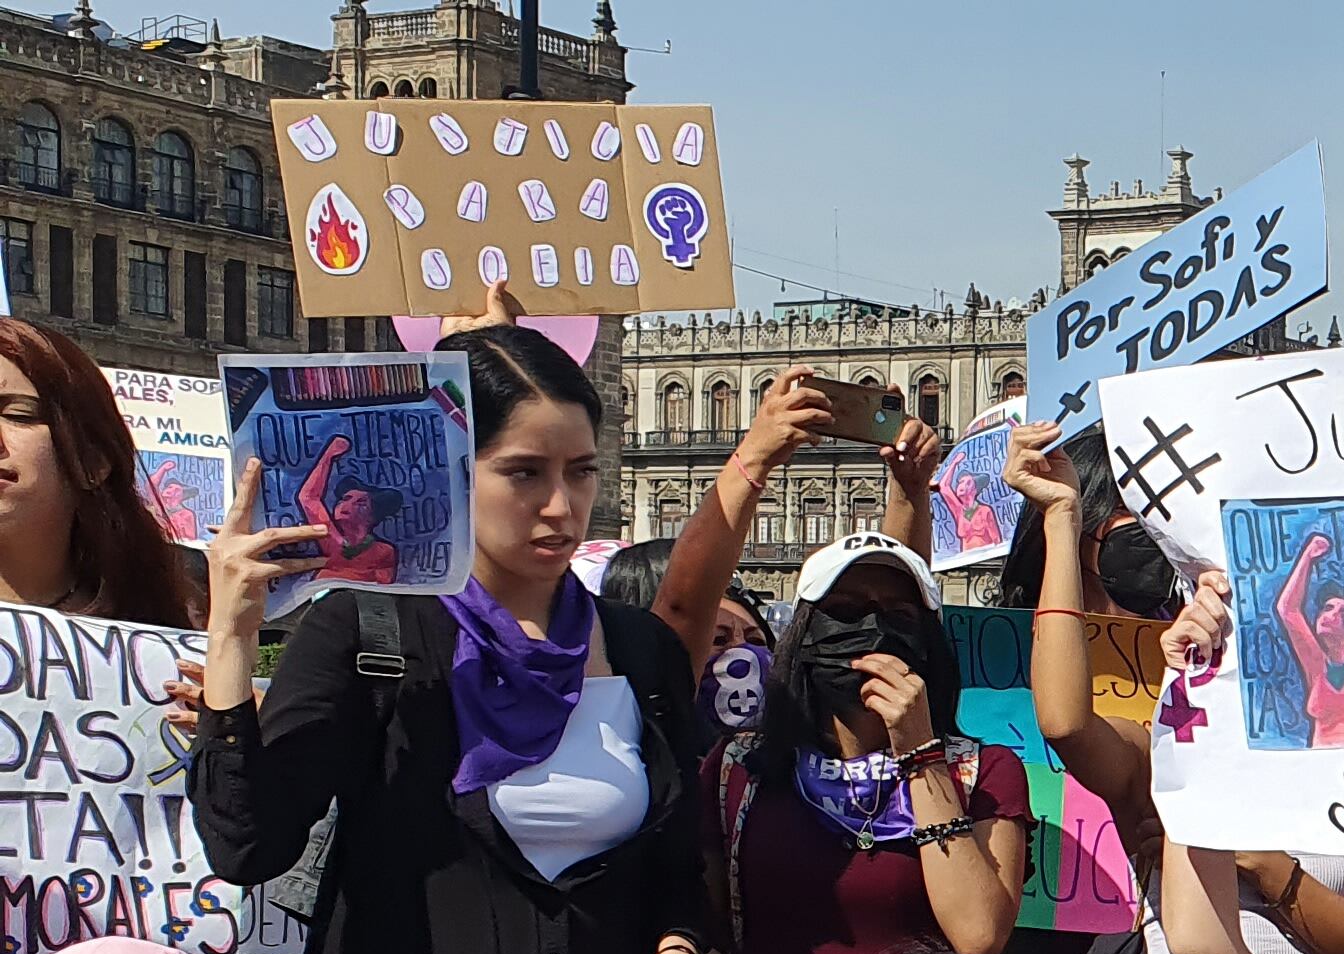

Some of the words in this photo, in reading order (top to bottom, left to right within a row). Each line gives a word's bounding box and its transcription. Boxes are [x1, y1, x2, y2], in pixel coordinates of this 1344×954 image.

[294, 112, 700, 163] JUSTICIA
[385, 180, 608, 228] PARA
[1057, 296, 1135, 360] Por
[1140, 215, 1234, 310] Sofi
[1116, 243, 1291, 373] TODAS
[116, 371, 173, 390] PARA
[157, 417, 182, 432] MI
[159, 431, 229, 449] AMIGA
[257, 412, 322, 467] QUE
[340, 410, 446, 470] TIEMBLE
[337, 457, 426, 498] ESTADO
[1230, 508, 1299, 574] QUE
[1235, 575, 1271, 626] EL
[1240, 624, 1291, 680] LOS
[1247, 675, 1301, 739] LAS
[0, 791, 187, 874] TA!!
